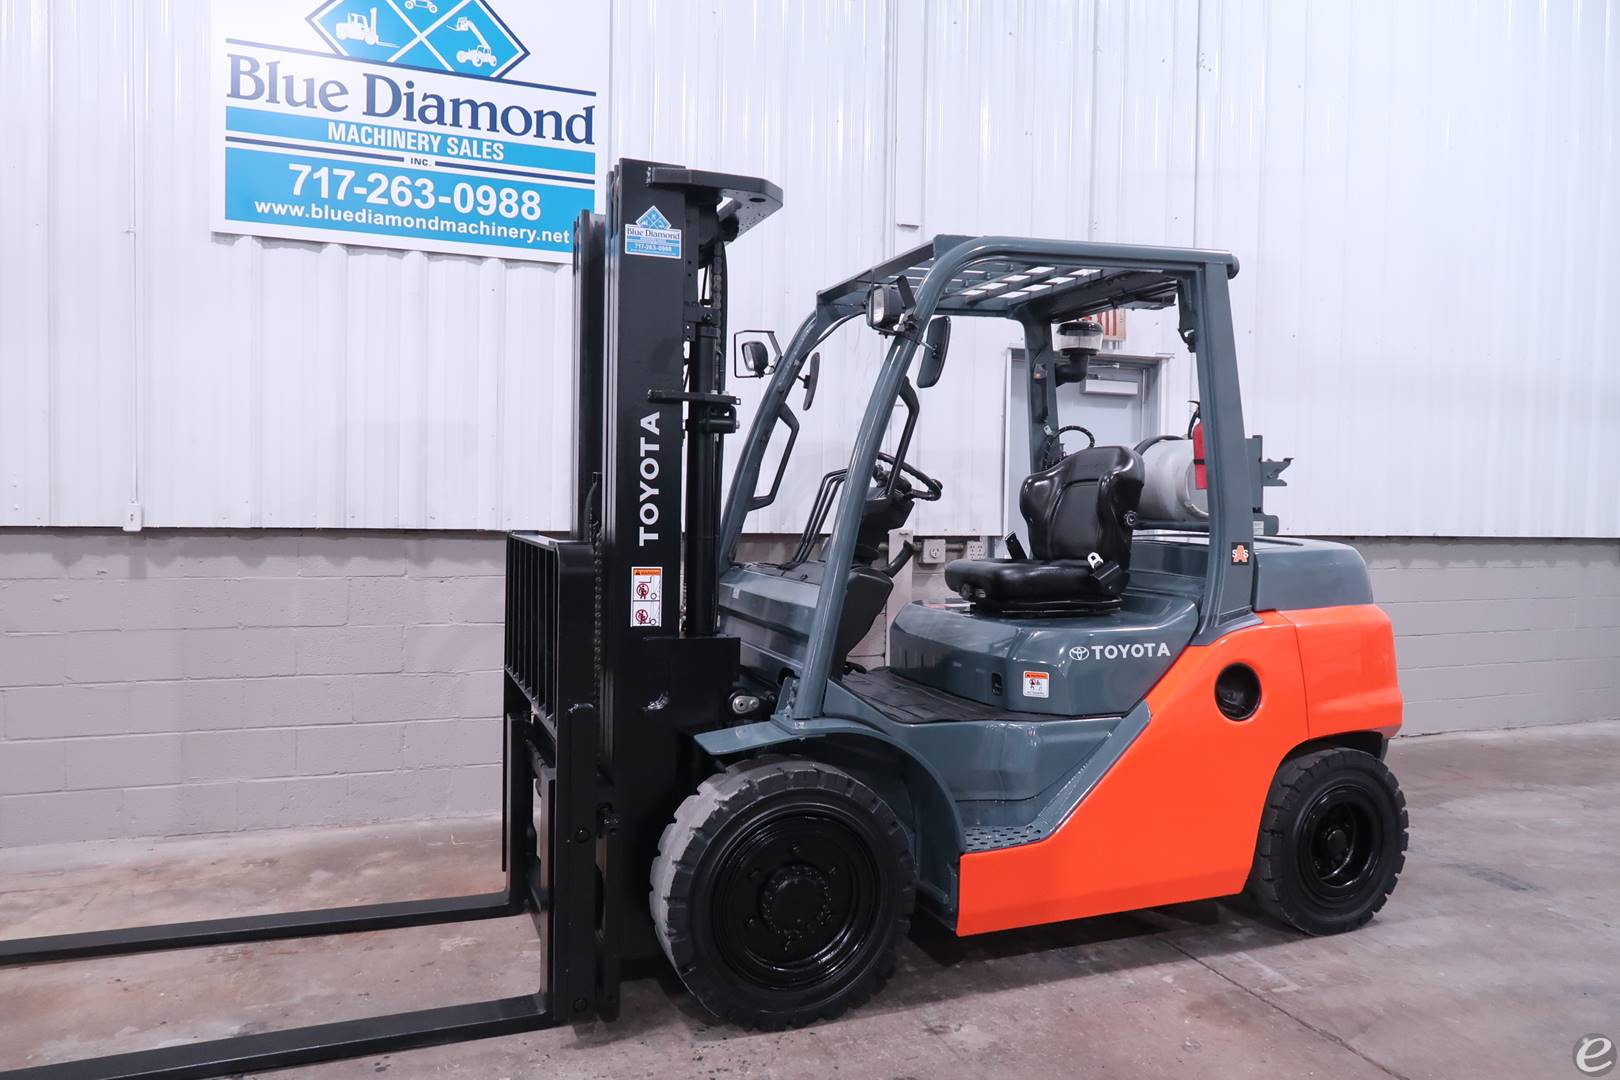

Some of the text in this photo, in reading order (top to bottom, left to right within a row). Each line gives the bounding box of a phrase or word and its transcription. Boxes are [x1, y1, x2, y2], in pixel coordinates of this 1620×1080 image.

[226, 53, 595, 145] Blue Diamond
[327, 121, 505, 161] MACHINERY SALES
[410, 157, 432, 167] INC.
[288, 163, 541, 221] 717-263-0988
[254, 201, 571, 244] www.bluediamondmachinery.net
[627, 227, 680, 239] Blue Diamond
[639, 411, 660, 546] TOYOTA
[1091, 642, 1171, 660] TOYOTA
